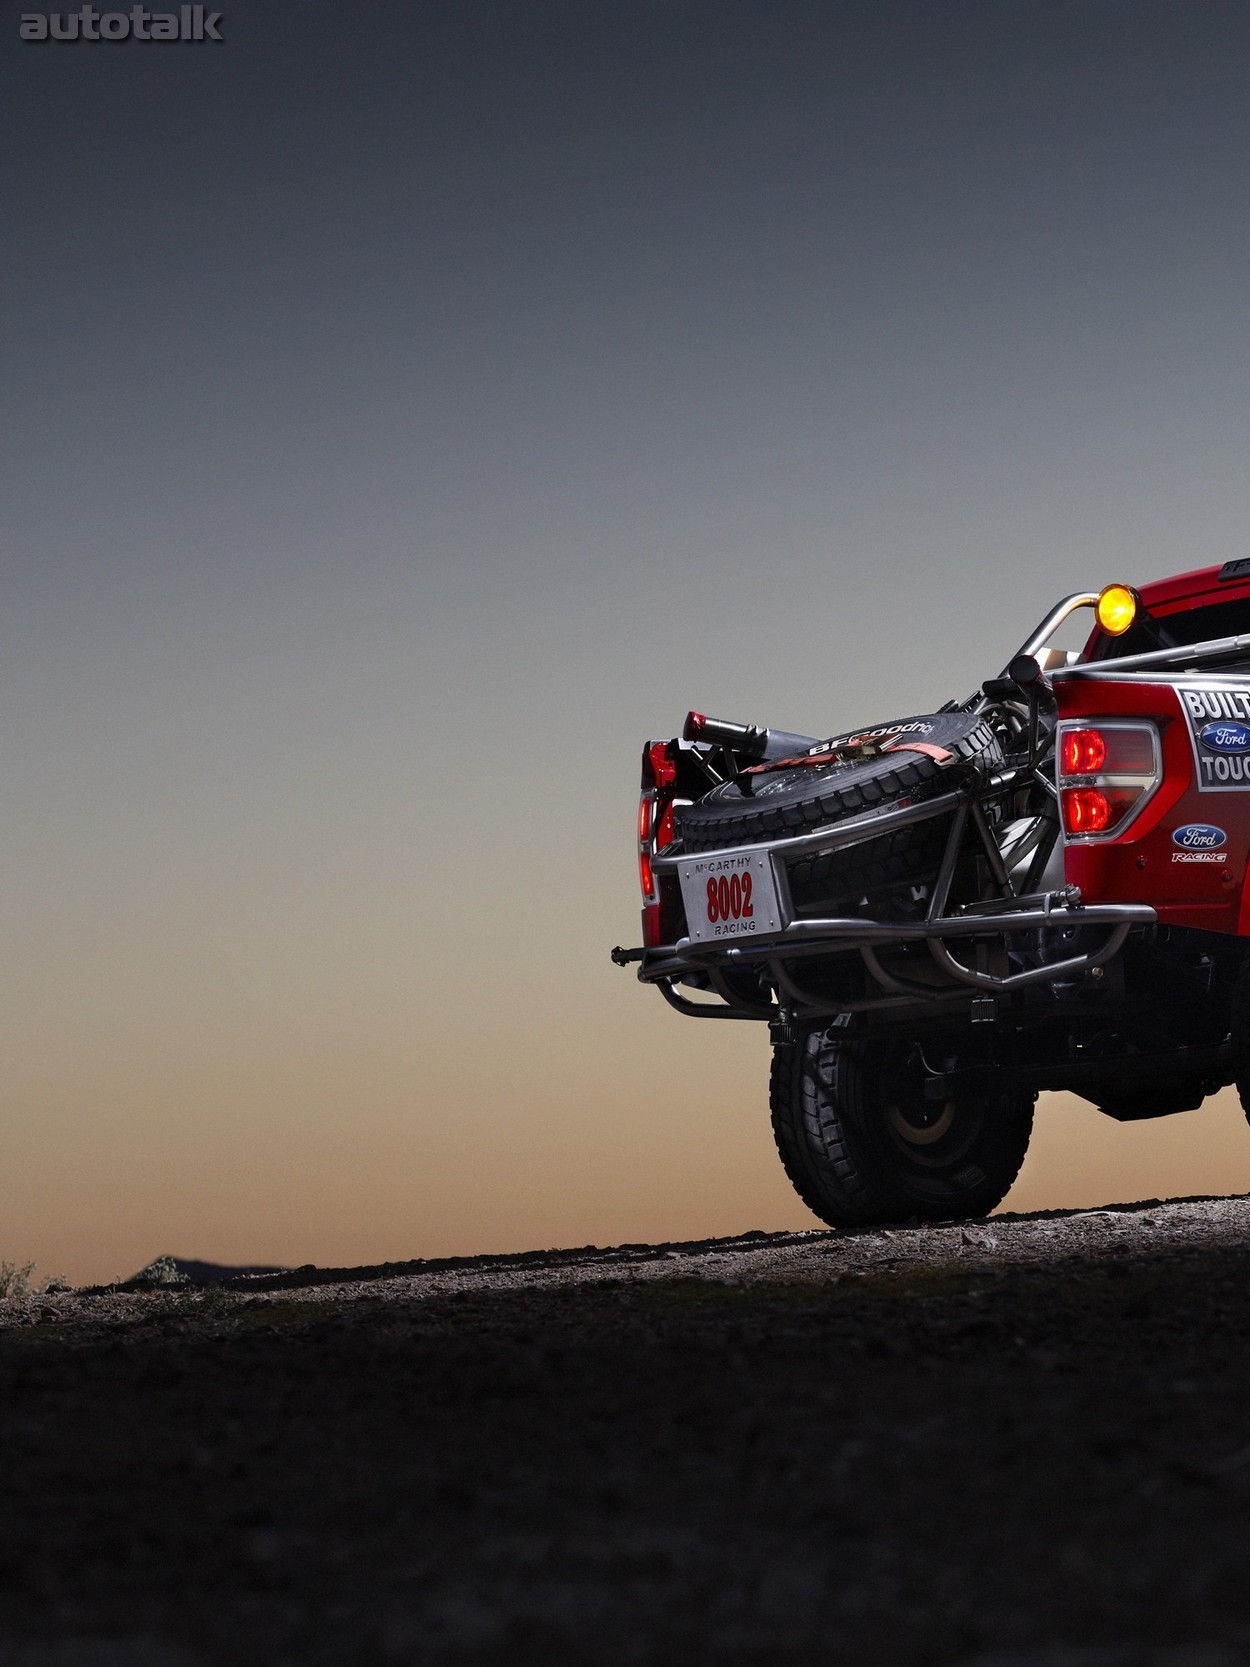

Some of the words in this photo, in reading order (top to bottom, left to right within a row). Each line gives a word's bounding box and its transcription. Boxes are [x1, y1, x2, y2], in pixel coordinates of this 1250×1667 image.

[1215, 727, 1247, 746] Ford
[1183, 827, 1217, 846] Ford
[1172, 853, 1227, 862] RACING
[707, 871, 753, 923] 8002
[714, 921, 756, 935] RACING
